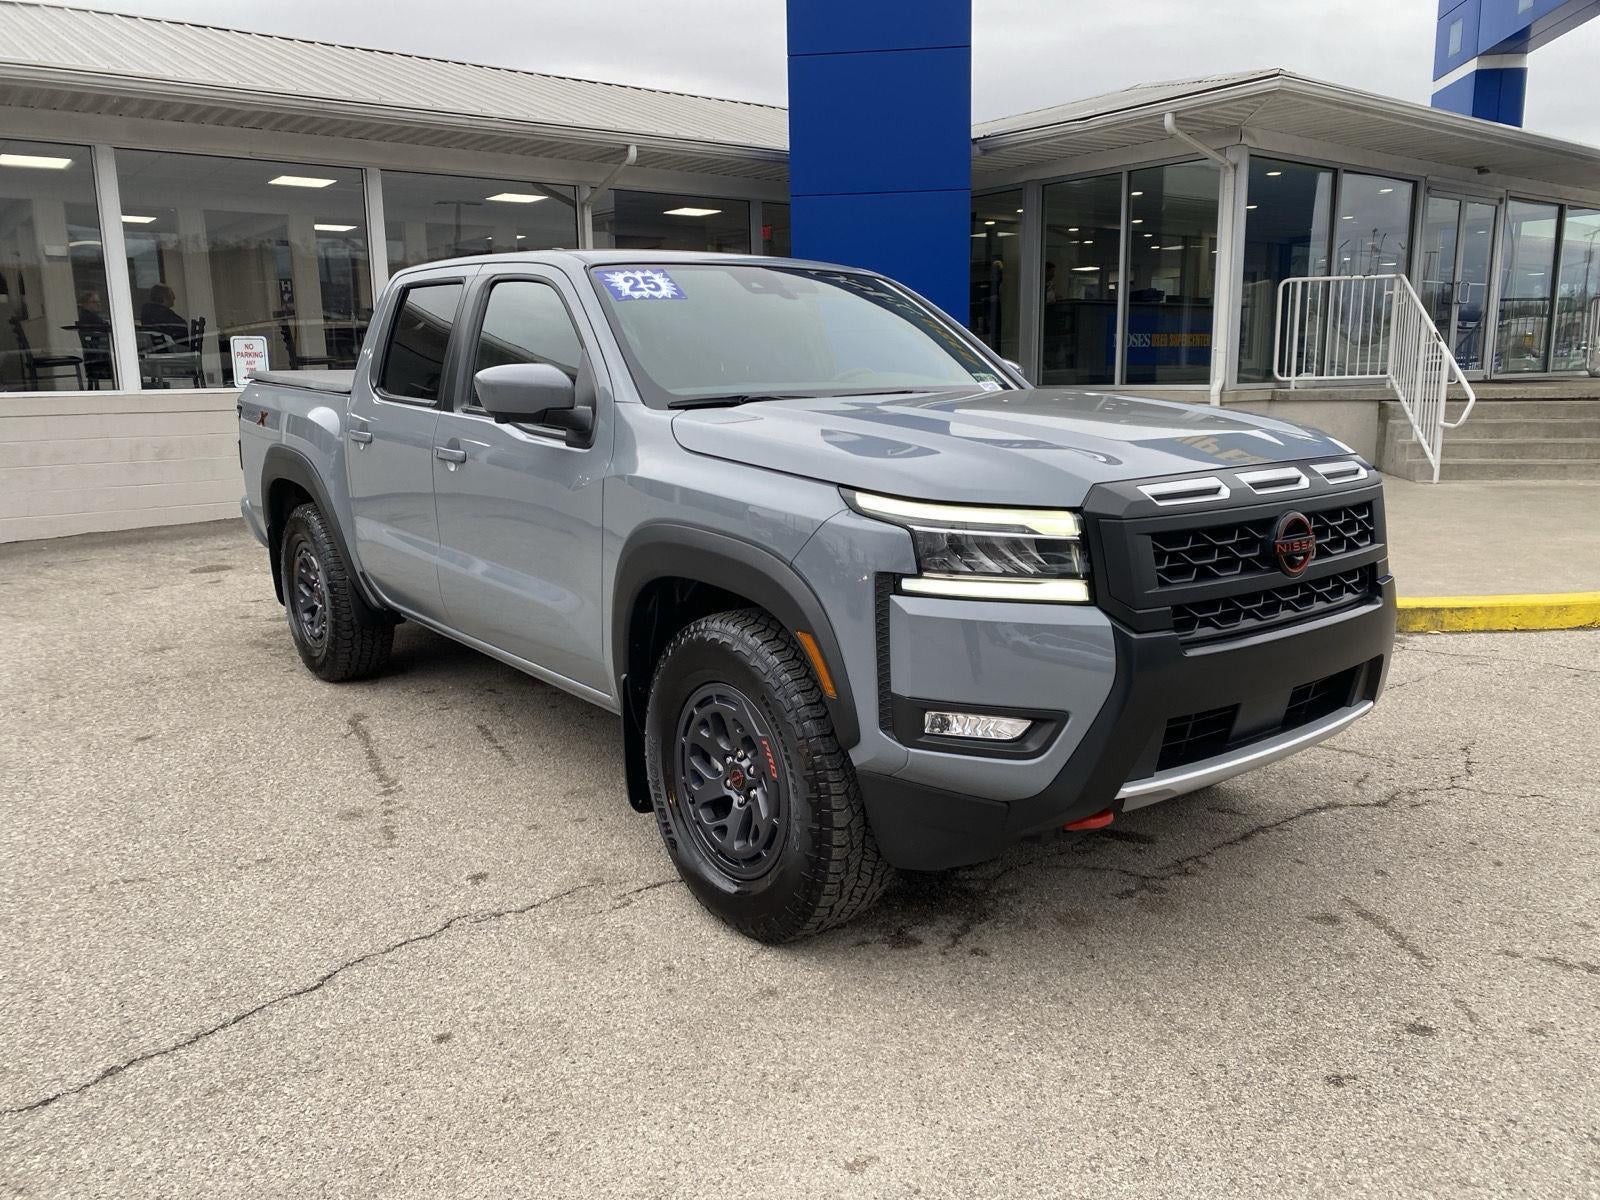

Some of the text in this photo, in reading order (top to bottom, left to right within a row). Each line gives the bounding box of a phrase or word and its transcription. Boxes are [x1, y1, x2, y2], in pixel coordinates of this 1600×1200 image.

[622, 276, 663, 292] 25
[236, 351, 263, 359] PARKING
[761, 738, 778, 779] PRO
